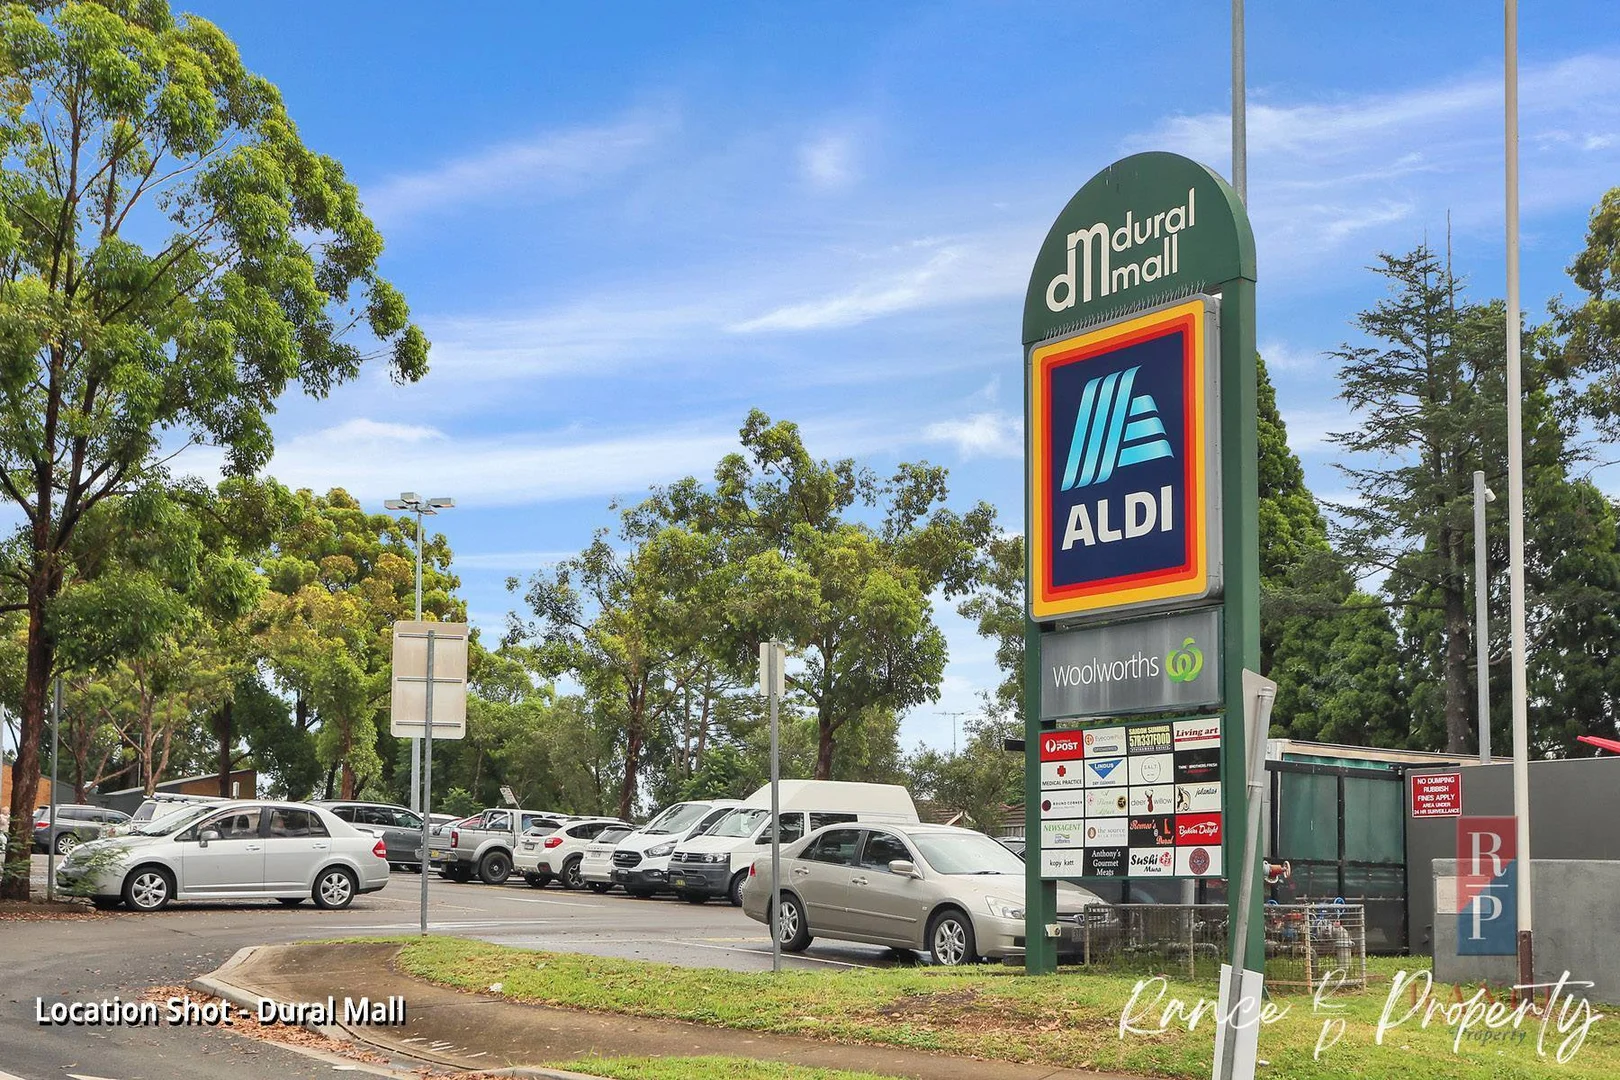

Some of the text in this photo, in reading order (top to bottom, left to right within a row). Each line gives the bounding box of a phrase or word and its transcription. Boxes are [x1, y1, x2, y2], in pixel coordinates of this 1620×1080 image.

[1111, 187, 1195, 252] dural
[1111, 232, 1179, 294] mall
[1061, 484, 1173, 551] ALDI
[1052, 651, 1160, 688] Woolworths
[1175, 727, 1218, 737] Living art
[1056, 742, 1079, 752] POST
[1427, 776, 1455, 784] DUMPING
[1417, 793, 1455, 802] FINES APPLY
[1130, 799, 1146, 807] deer
[1043, 823, 1082, 832] NEWSAGENT
[1178, 824, 1219, 838] Bakers Delight
[1091, 849, 1121, 859] Anthony's
[1049, 859, 1062, 868] kopy
[1092, 859, 1119, 867] Gourmet
[1130, 854, 1159, 866] Sushi
[1096, 868, 1114, 876] Meats
